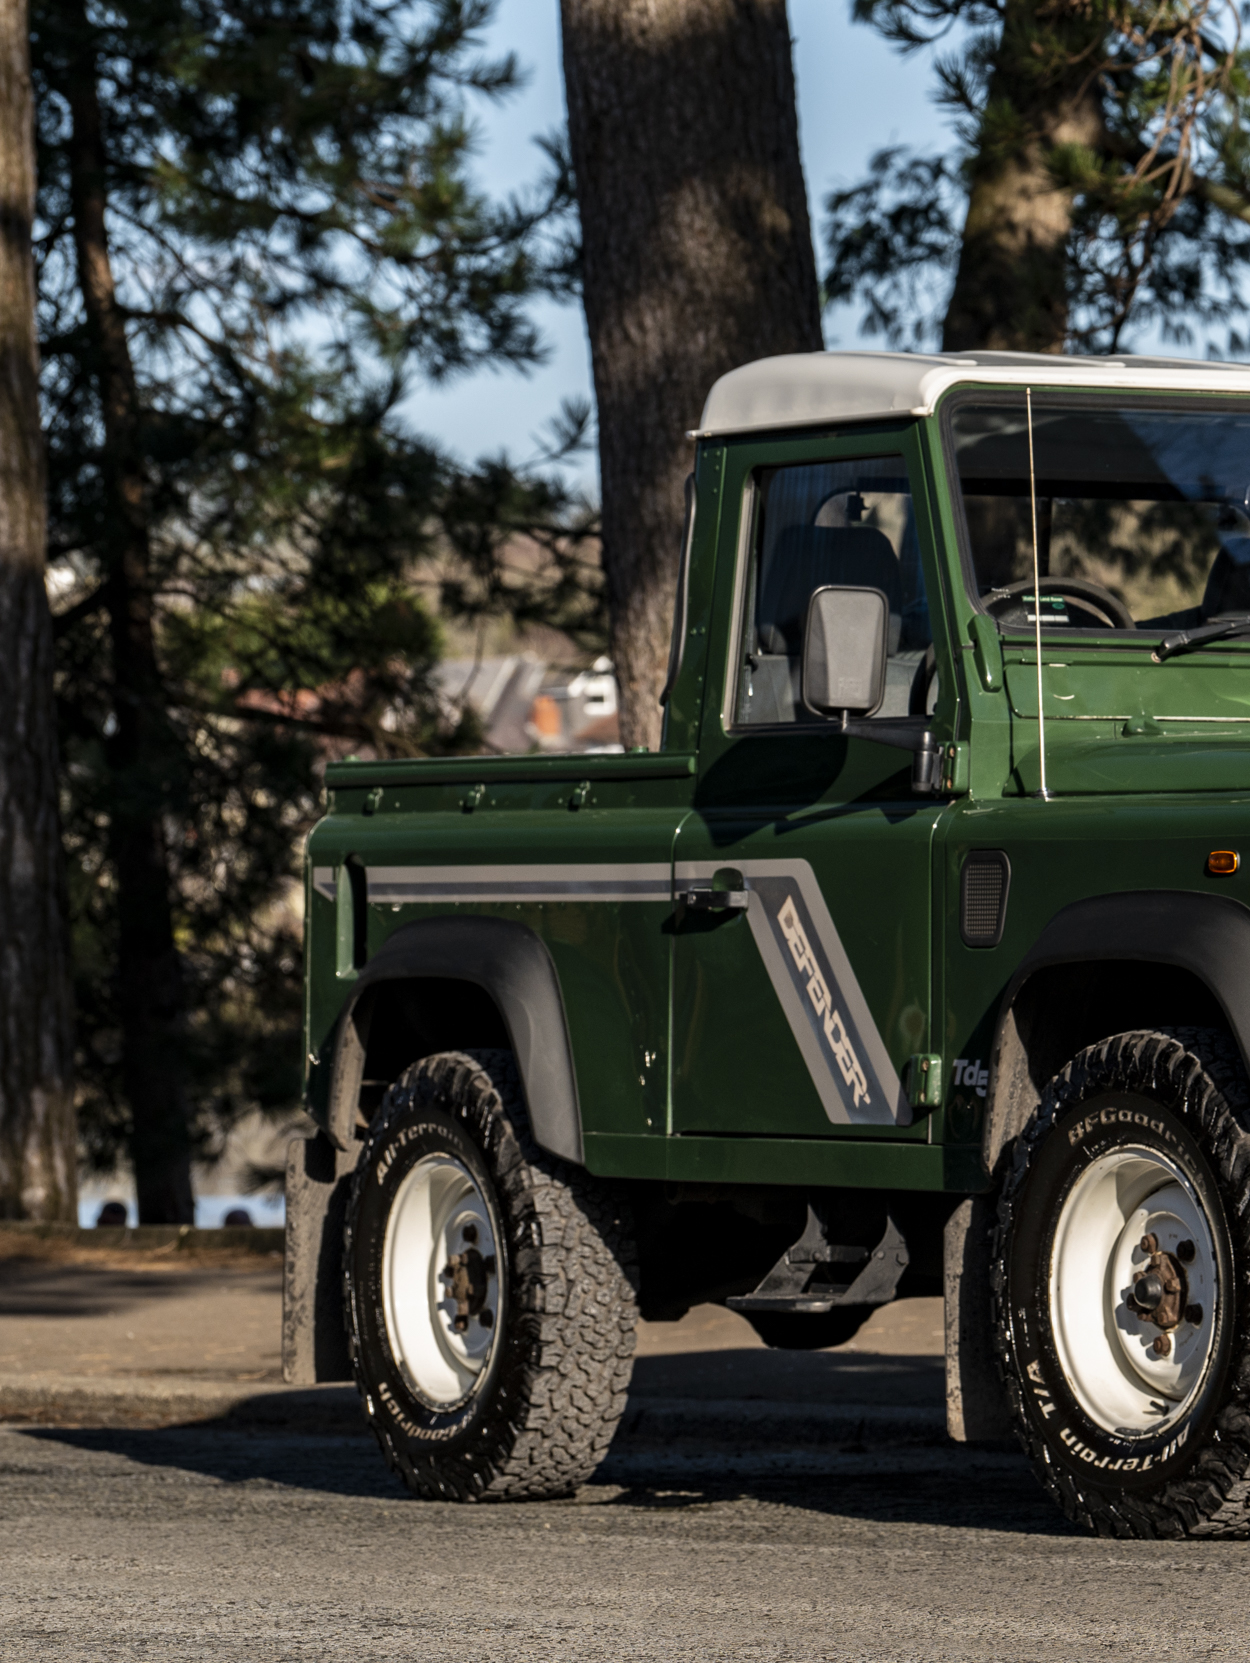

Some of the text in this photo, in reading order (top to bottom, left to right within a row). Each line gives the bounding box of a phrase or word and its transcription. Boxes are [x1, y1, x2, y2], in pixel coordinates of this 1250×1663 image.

[777, 894, 871, 1108] DEFENDER
[953, 1059, 989, 1097] Td5
[1026, 1359, 1057, 1419] T/A
[1059, 1422, 1190, 1473] All-Terrain
